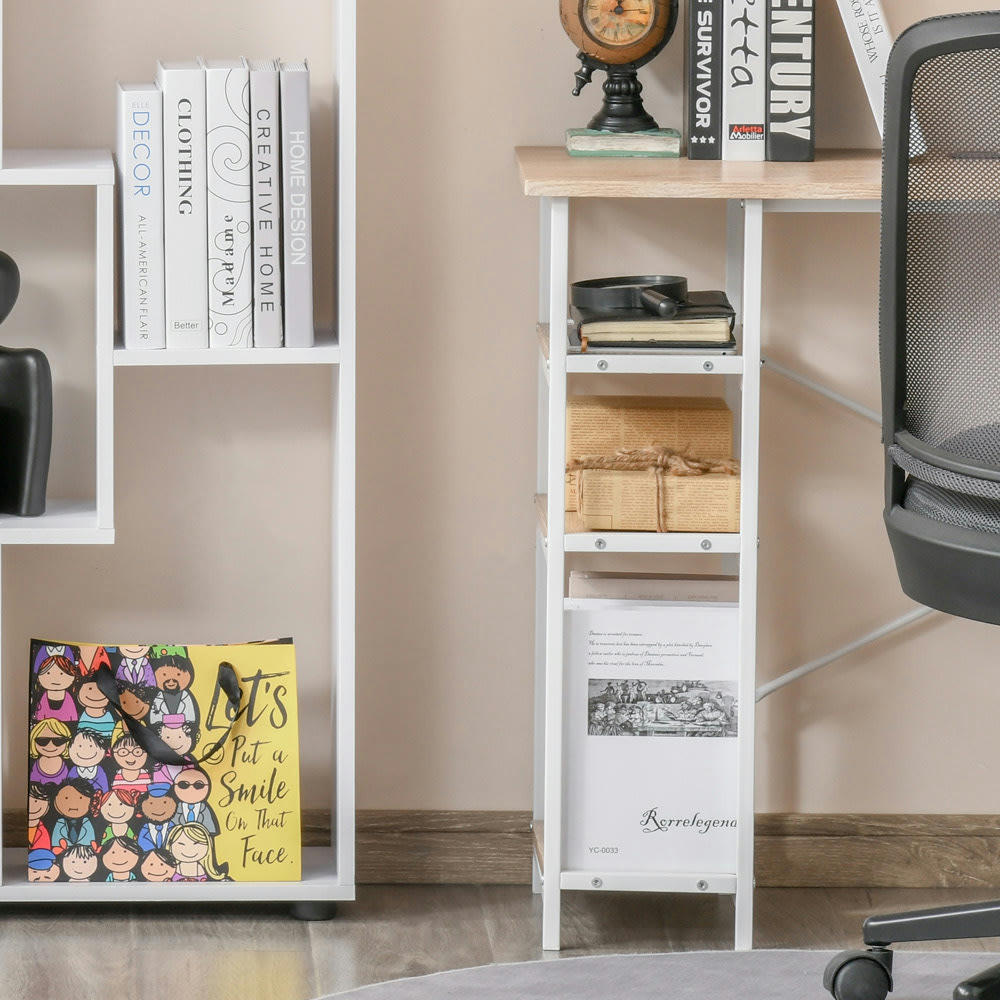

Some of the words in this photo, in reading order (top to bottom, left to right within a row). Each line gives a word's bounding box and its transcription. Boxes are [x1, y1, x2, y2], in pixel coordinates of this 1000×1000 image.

[868, 10, 880, 22] IT
[872, 23, 884, 35] IS
[857, 21, 878, 64] WHOSE
[695, 10, 714, 129] SURVIVOR
[133, 111, 150, 197] DECOR
[177, 98, 193, 215] CLOTHING
[729, 132, 764, 140] Mobilier
[257, 109, 273, 230] CREATIVE
[290, 131, 306, 187] HOME
[138, 215, 148, 306] ALL-AMERICAN
[222, 214, 235, 306] Madame
[260, 246, 274, 312] HOME
[140, 309, 148, 341] FLAIR
[174, 321, 199, 330] Better
[231, 735, 272, 767] Put
[272, 749, 289, 765] a
[218, 767, 290, 808] Smile
[225, 811, 249, 832] On
[255, 808, 294, 831] That
[588, 847, 620, 855] YC-0033
